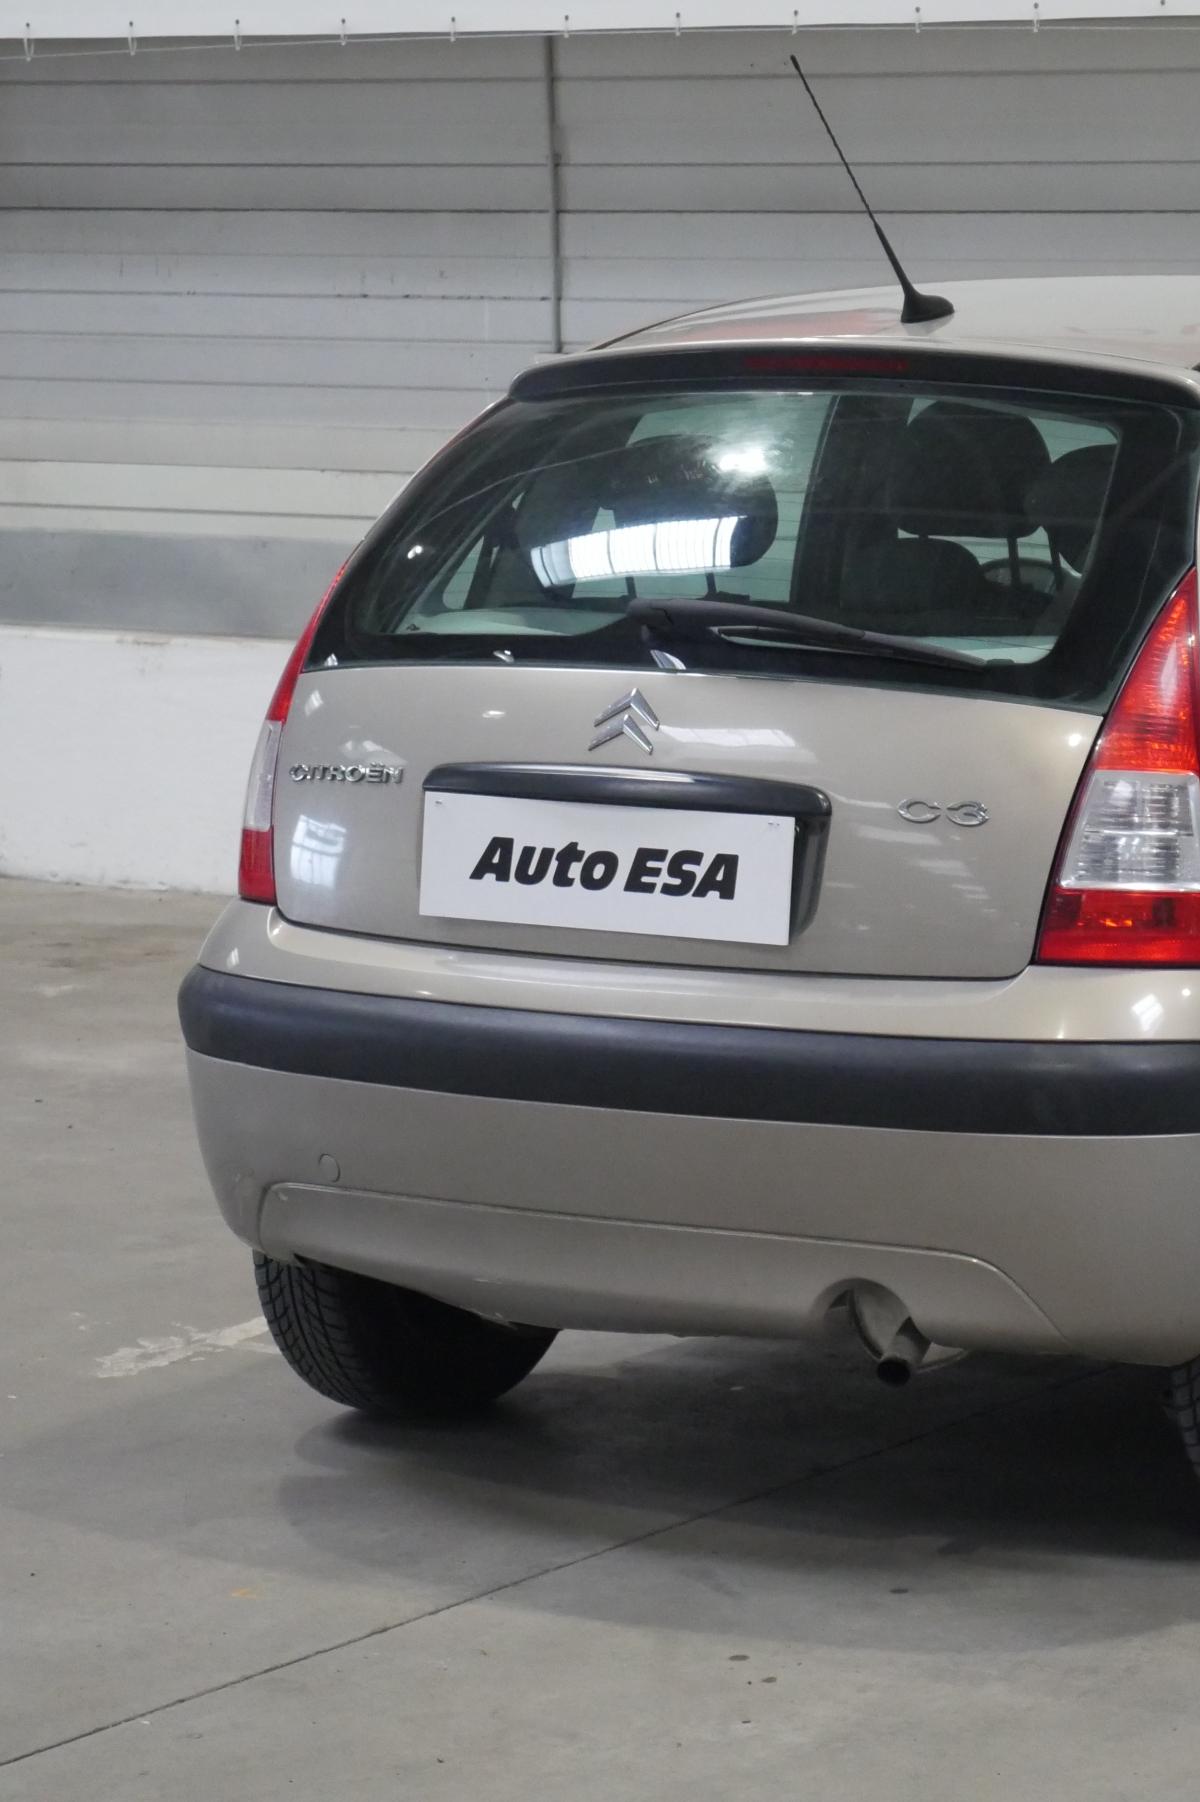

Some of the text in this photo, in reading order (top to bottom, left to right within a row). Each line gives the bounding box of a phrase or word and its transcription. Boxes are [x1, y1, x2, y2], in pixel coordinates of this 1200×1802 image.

[288, 761, 405, 784] CITROËN
[898, 798, 990, 828] C3
[469, 836, 739, 900] Auto ESA
